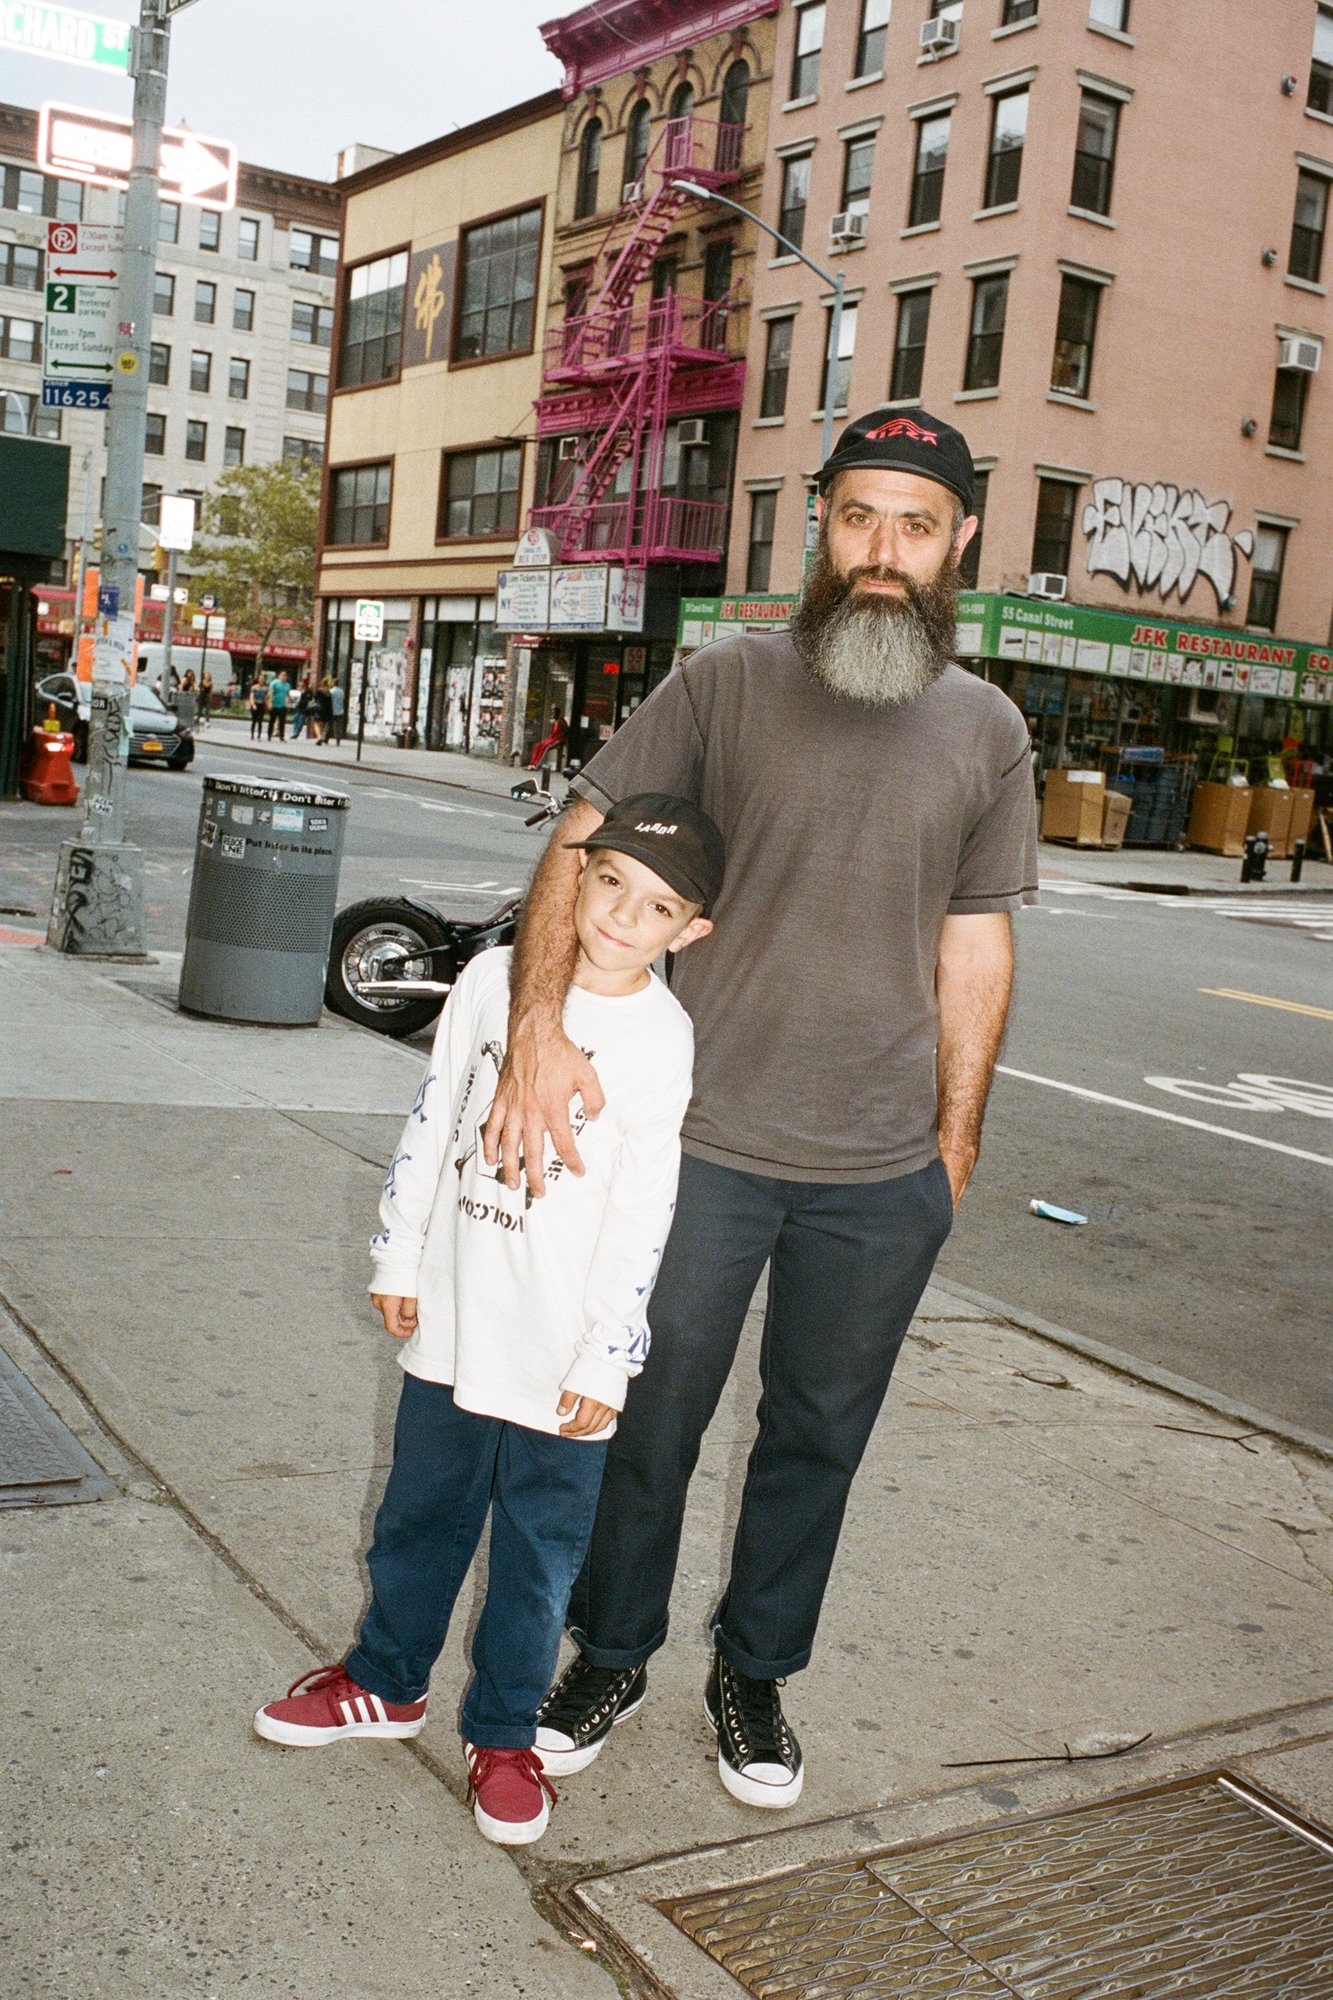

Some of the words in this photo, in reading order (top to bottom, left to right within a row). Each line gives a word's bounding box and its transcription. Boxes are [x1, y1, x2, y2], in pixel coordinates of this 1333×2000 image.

[101, 26, 129, 51] ST
[80, 242, 104, 252] Except
[53, 286, 69, 311] 2
[79, 299, 111, 308] metered
[79, 308, 107, 318] parking
[79, 328, 96, 339] 7pm
[49, 340, 79, 352] Except
[81, 343, 113, 354] Sunday
[1002, 605, 1014, 620] 55
[1015, 608, 1043, 625] Canal
[1044, 612, 1074, 630] Street
[1132, 625, 1168, 648] JFK
[1177, 632, 1296, 666] RESTAURANT
[1308, 653, 1333, 672] EQ
[215, 780, 237, 791] Don't
[283, 791, 311, 804] Don't
[246, 837, 262, 848] Put
[301, 845, 312, 854] its
